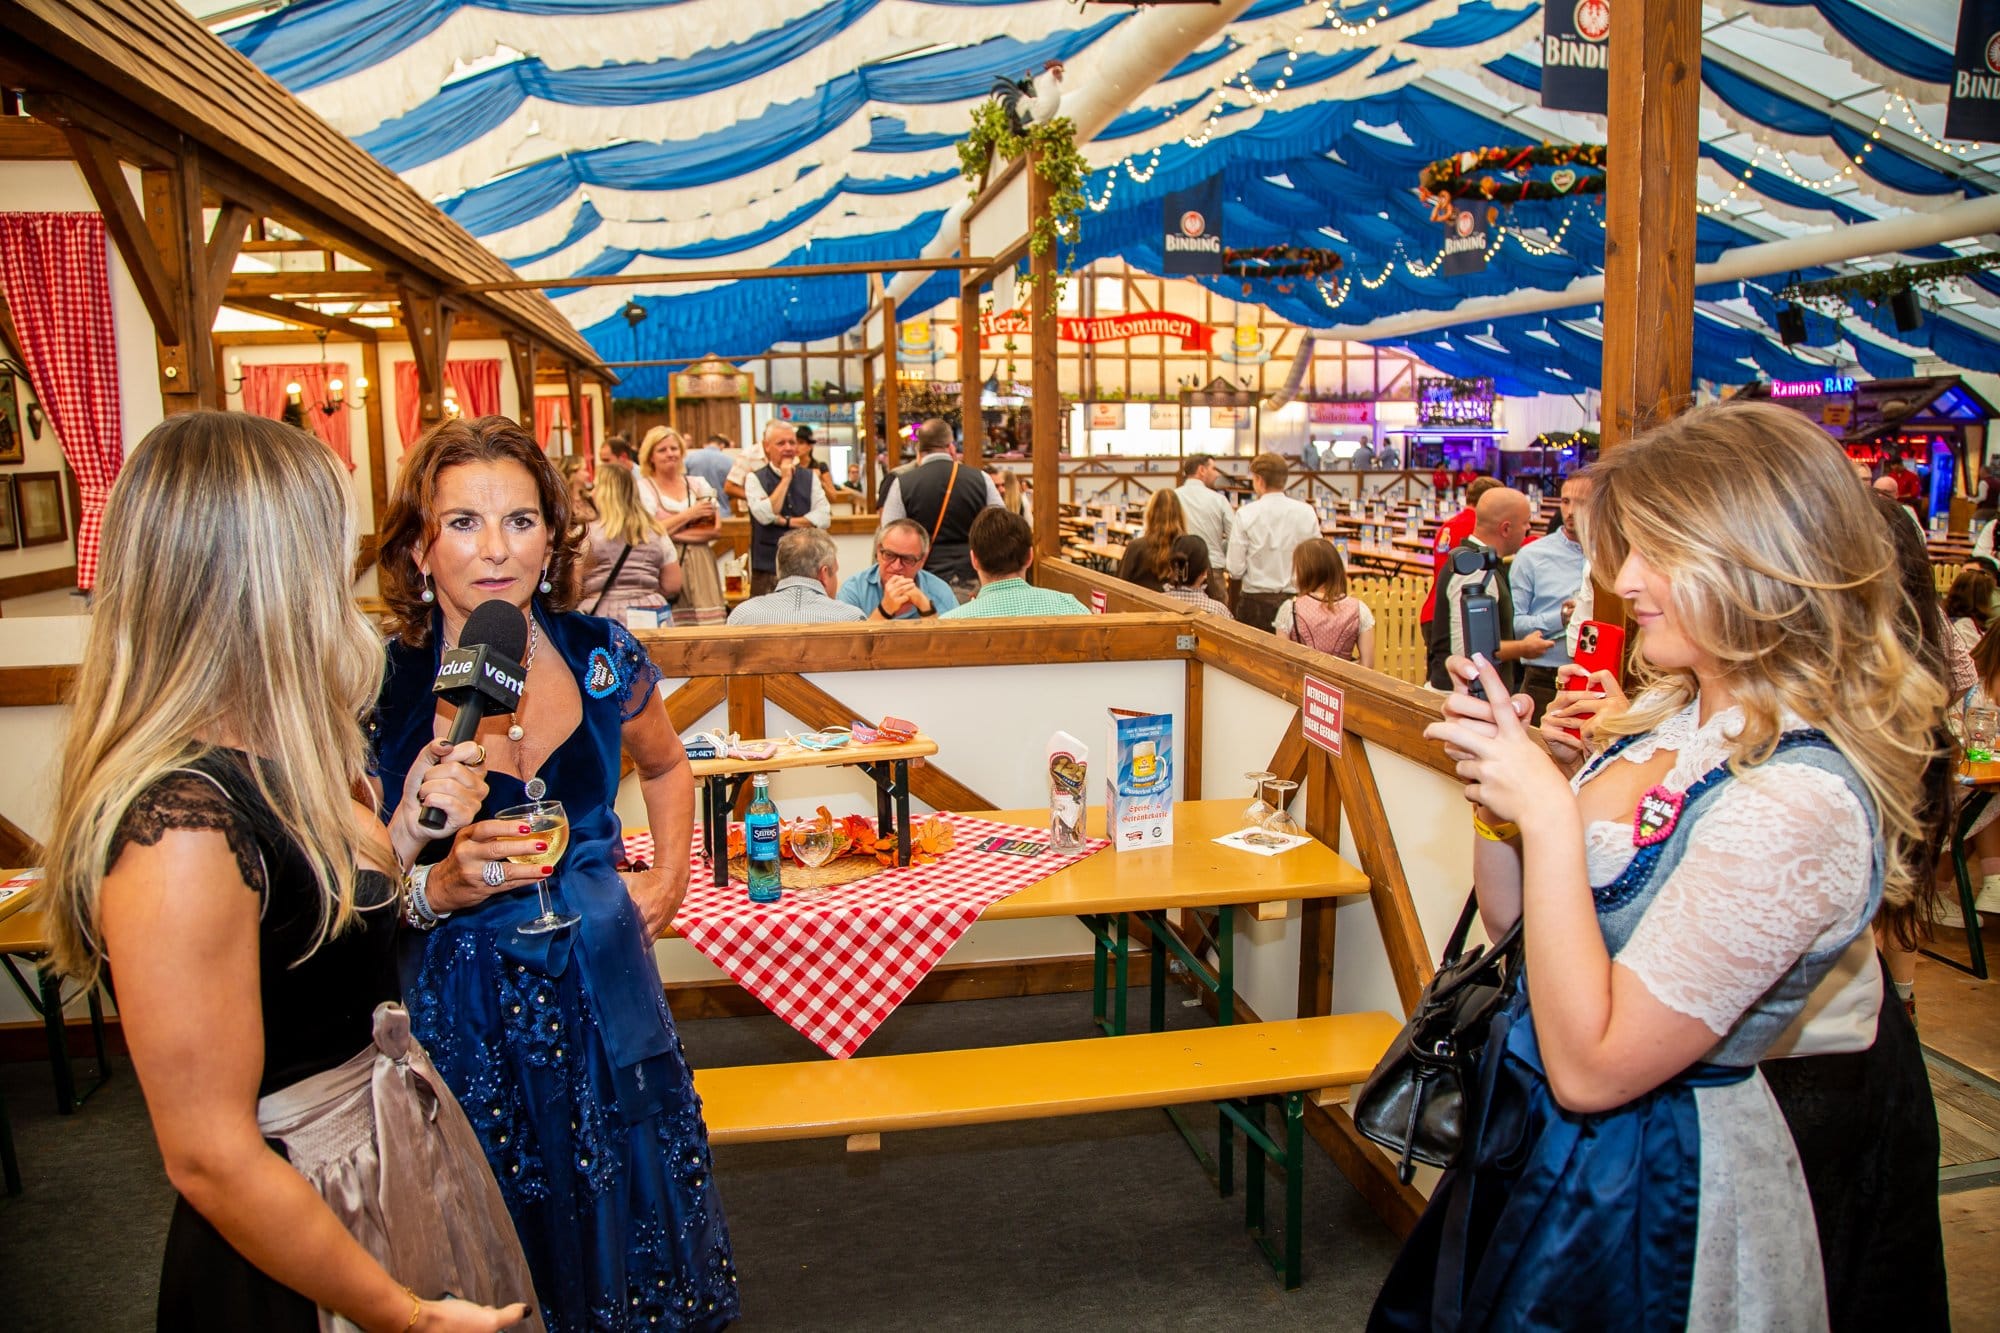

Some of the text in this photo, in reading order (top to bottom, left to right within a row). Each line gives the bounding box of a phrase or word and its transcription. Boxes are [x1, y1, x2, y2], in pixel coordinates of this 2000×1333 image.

[1545, 34, 1609, 70] BINDI
[1165, 233, 1221, 254] BINDING
[1445, 231, 1487, 256] BINDING
[1069, 319, 1193, 341] Willkommen
[1773, 376, 1855, 396] Ramons BAR
